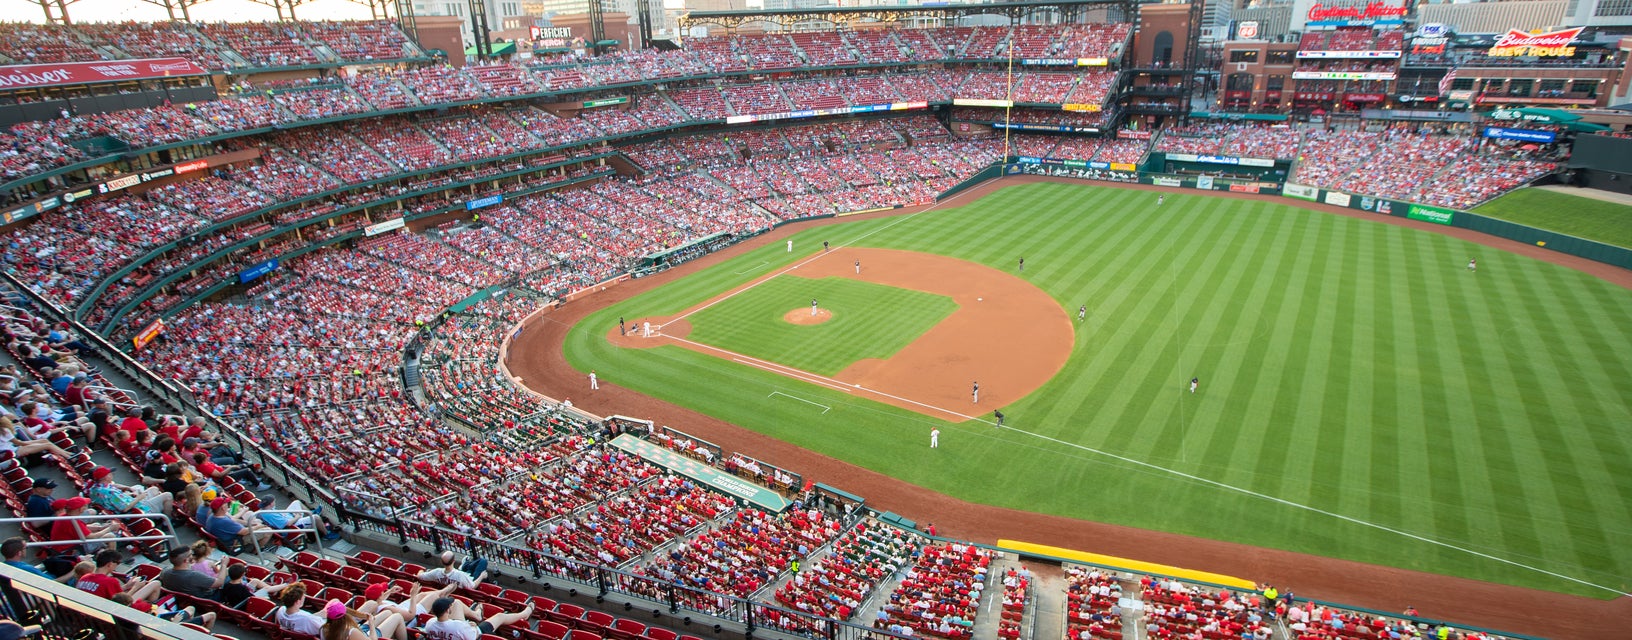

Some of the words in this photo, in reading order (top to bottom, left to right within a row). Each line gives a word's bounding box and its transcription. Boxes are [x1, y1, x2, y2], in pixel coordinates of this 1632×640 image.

[1308, 3, 1358, 20] Cardinals
[1358, 2, 1405, 19] Nation
[531, 27, 571, 40] PERFICIENT
[1240, 27, 1256, 37] 66
[1493, 34, 1580, 46] Budweiser
[1488, 46, 1527, 56] BREW
[1528, 46, 1576, 56] HOUSE
[1419, 208, 1452, 219] National
[712, 478, 755, 498] CHAMPIONS
